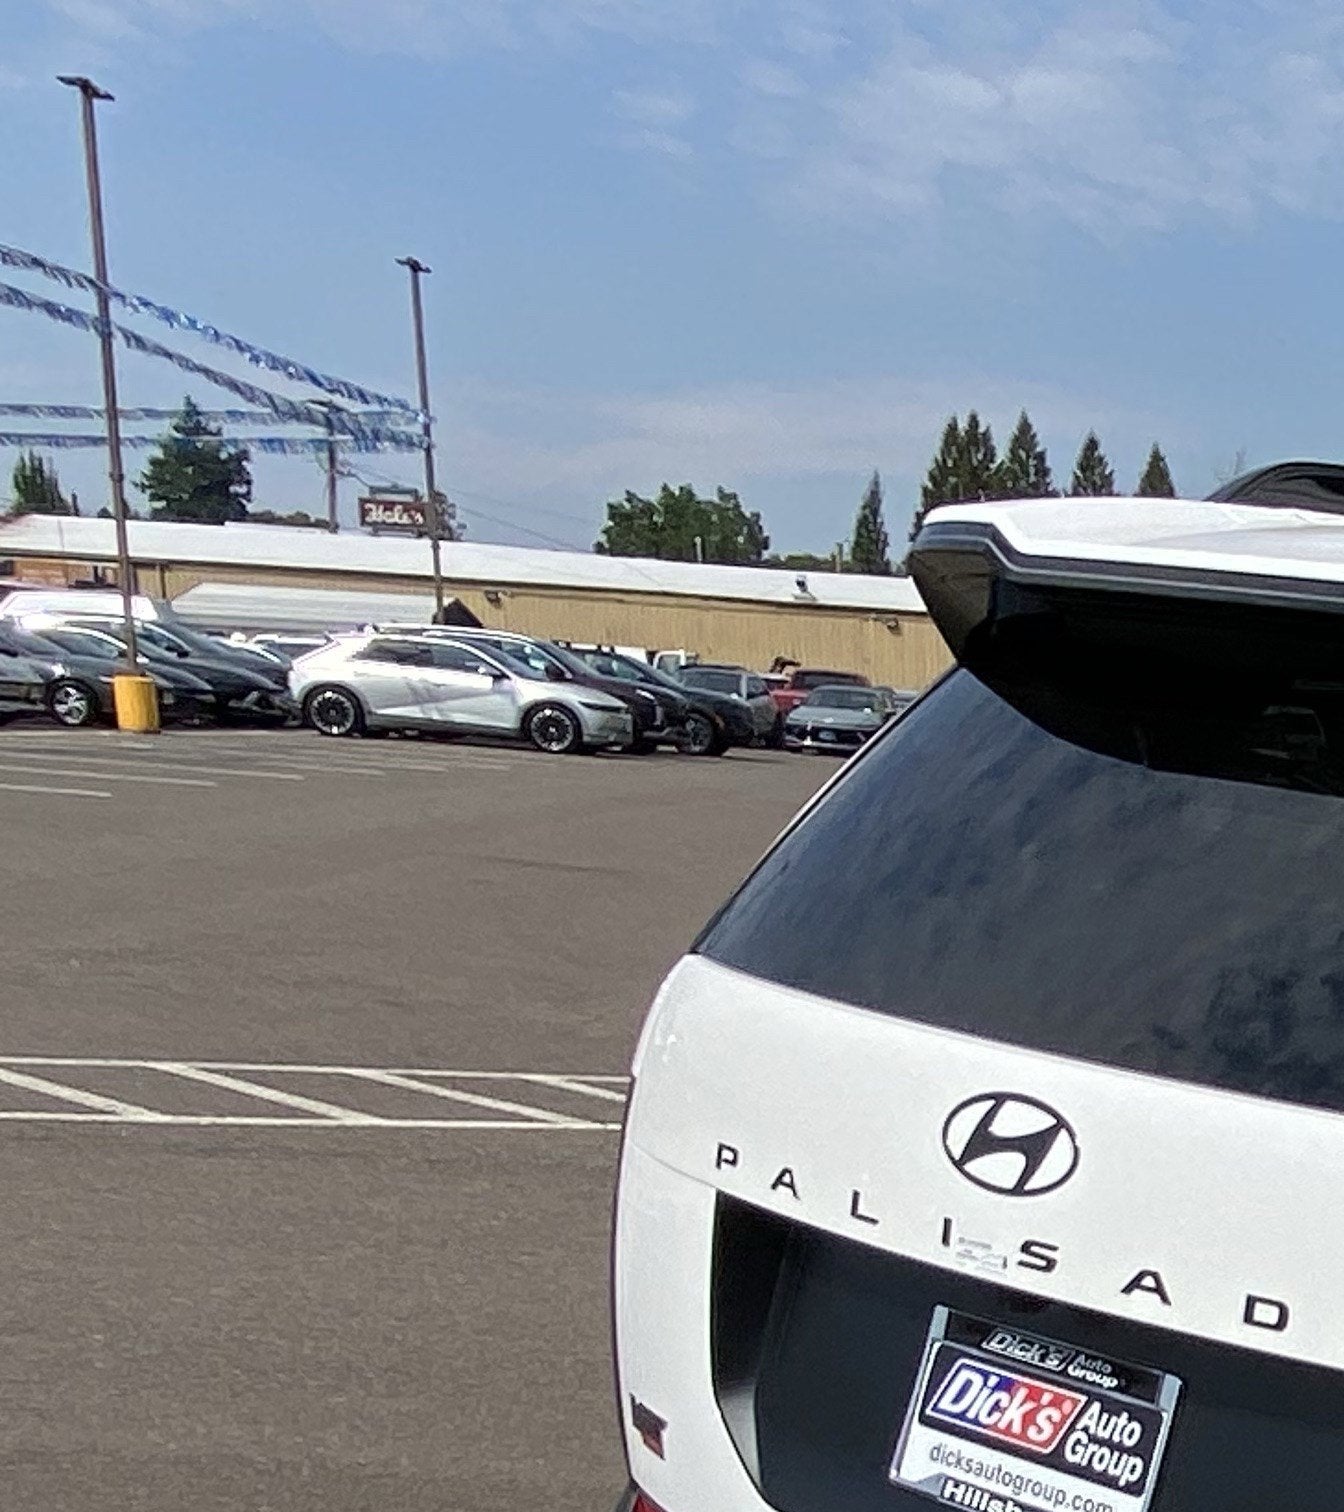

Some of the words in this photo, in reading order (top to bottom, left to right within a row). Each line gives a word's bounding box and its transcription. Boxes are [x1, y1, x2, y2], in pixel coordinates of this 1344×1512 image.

[986, 1331, 1064, 1367] Dick's
[1073, 1352, 1113, 1375] Auto
[1067, 1364, 1119, 1389] Group
[936, 1369, 1063, 1442] Dick's
[1075, 1401, 1143, 1448] Auto
[1063, 1430, 1145, 1487] Group
